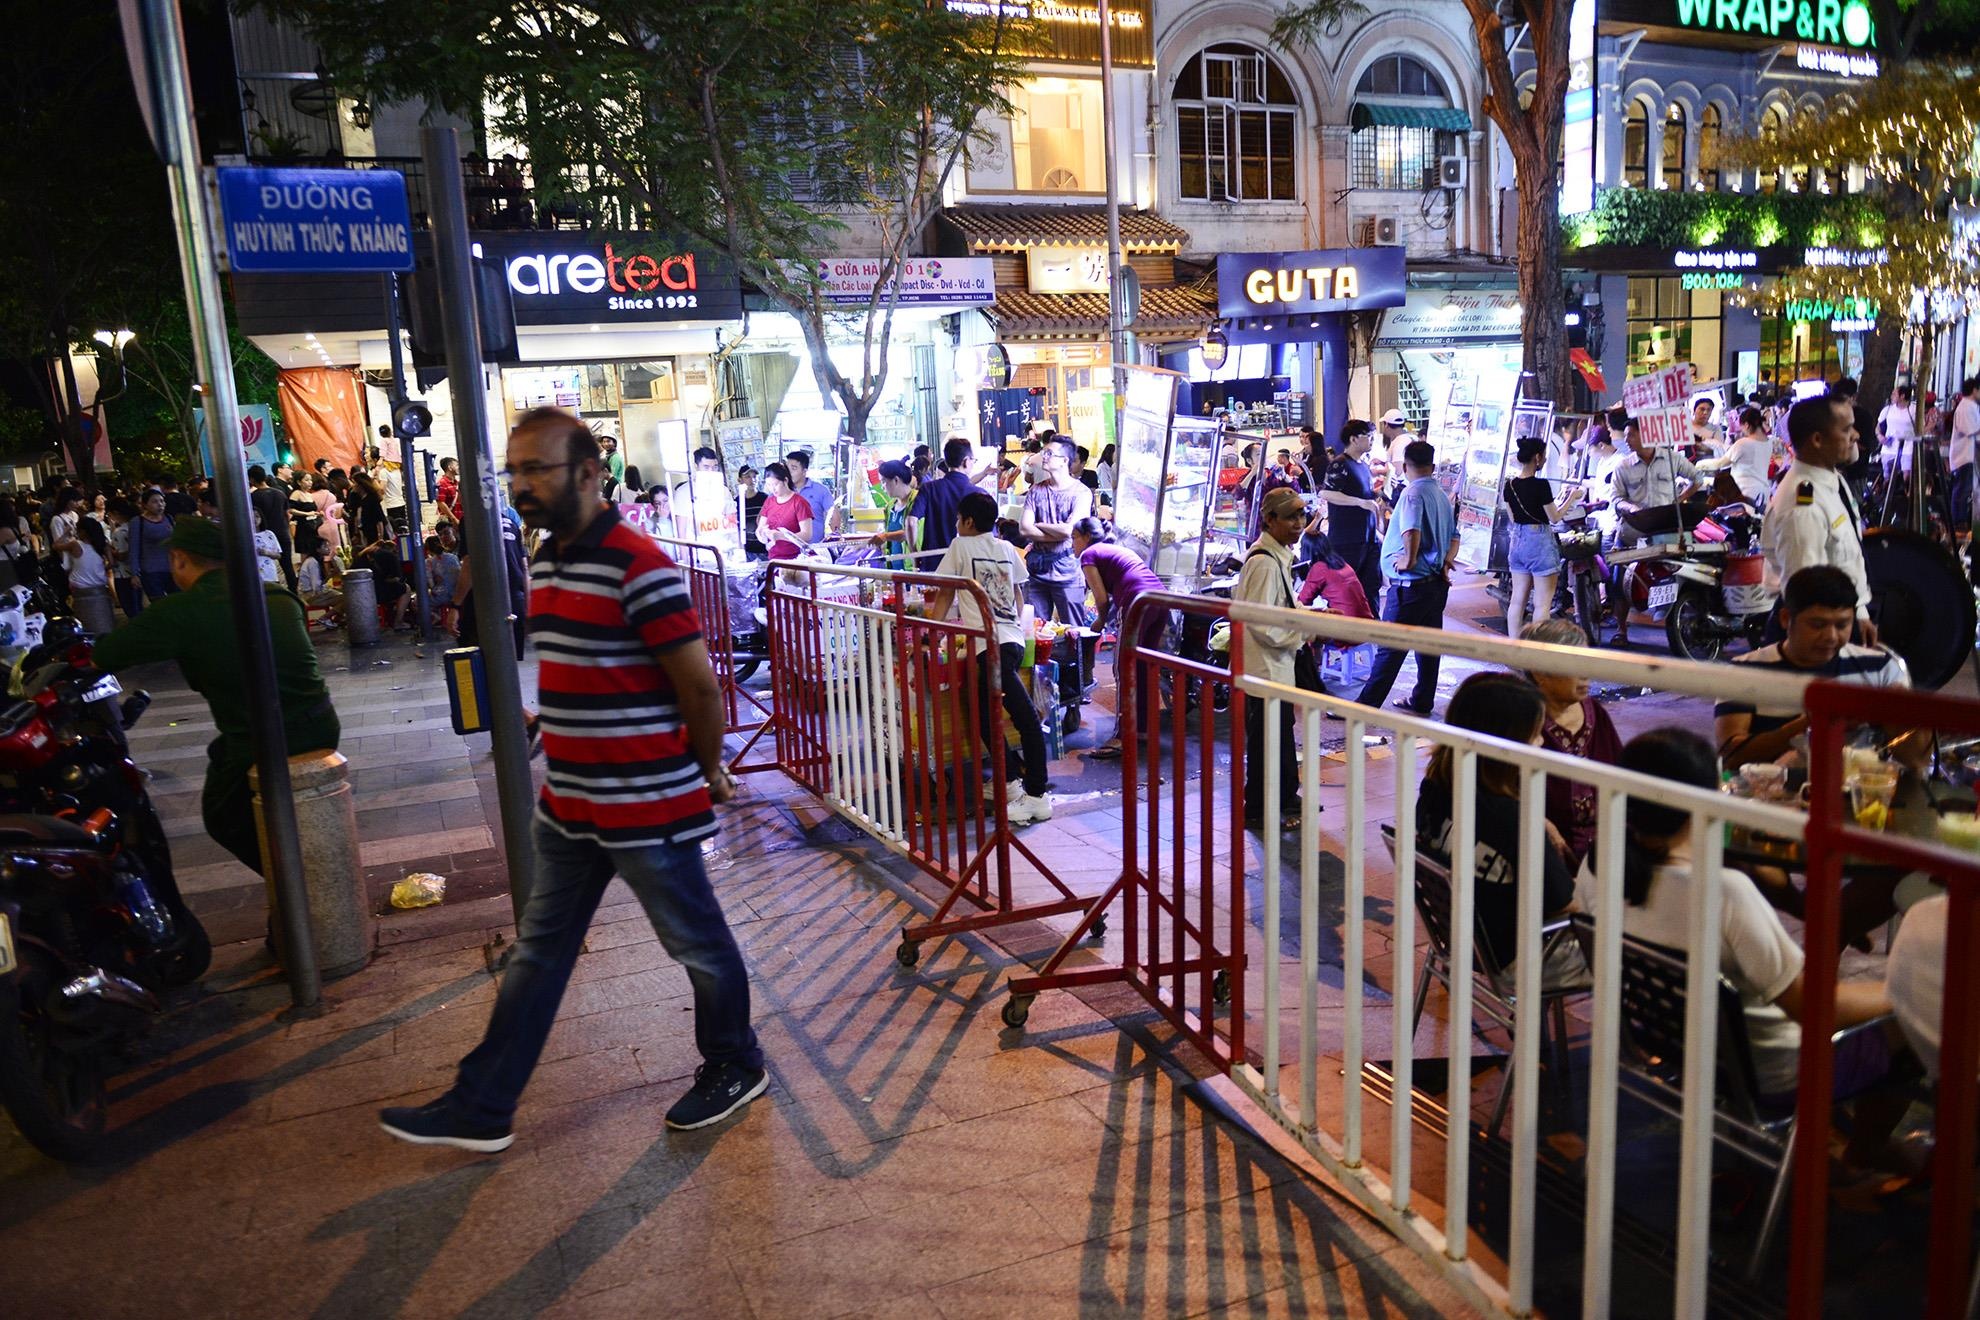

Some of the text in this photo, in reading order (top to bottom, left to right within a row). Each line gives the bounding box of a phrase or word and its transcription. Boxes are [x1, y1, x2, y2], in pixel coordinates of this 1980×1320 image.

[260, 180, 374, 210] ĐƯỜNG
[233, 214, 409, 254] HUỲNH THÚC KHÁNG
[835, 261, 859, 276] CỬA
[918, 264, 925, 276] 1
[841, 280, 856, 291] Các
[856, 280, 872, 293] Loại
[920, 279, 935, 290] Disc
[940, 279, 953, 290] Dvd
[958, 278, 971, 289] Vcd
[975, 278, 985, 289] Cd
[1246, 266, 1358, 304] GUTA
[608, 296, 698, 310] Since 1992
